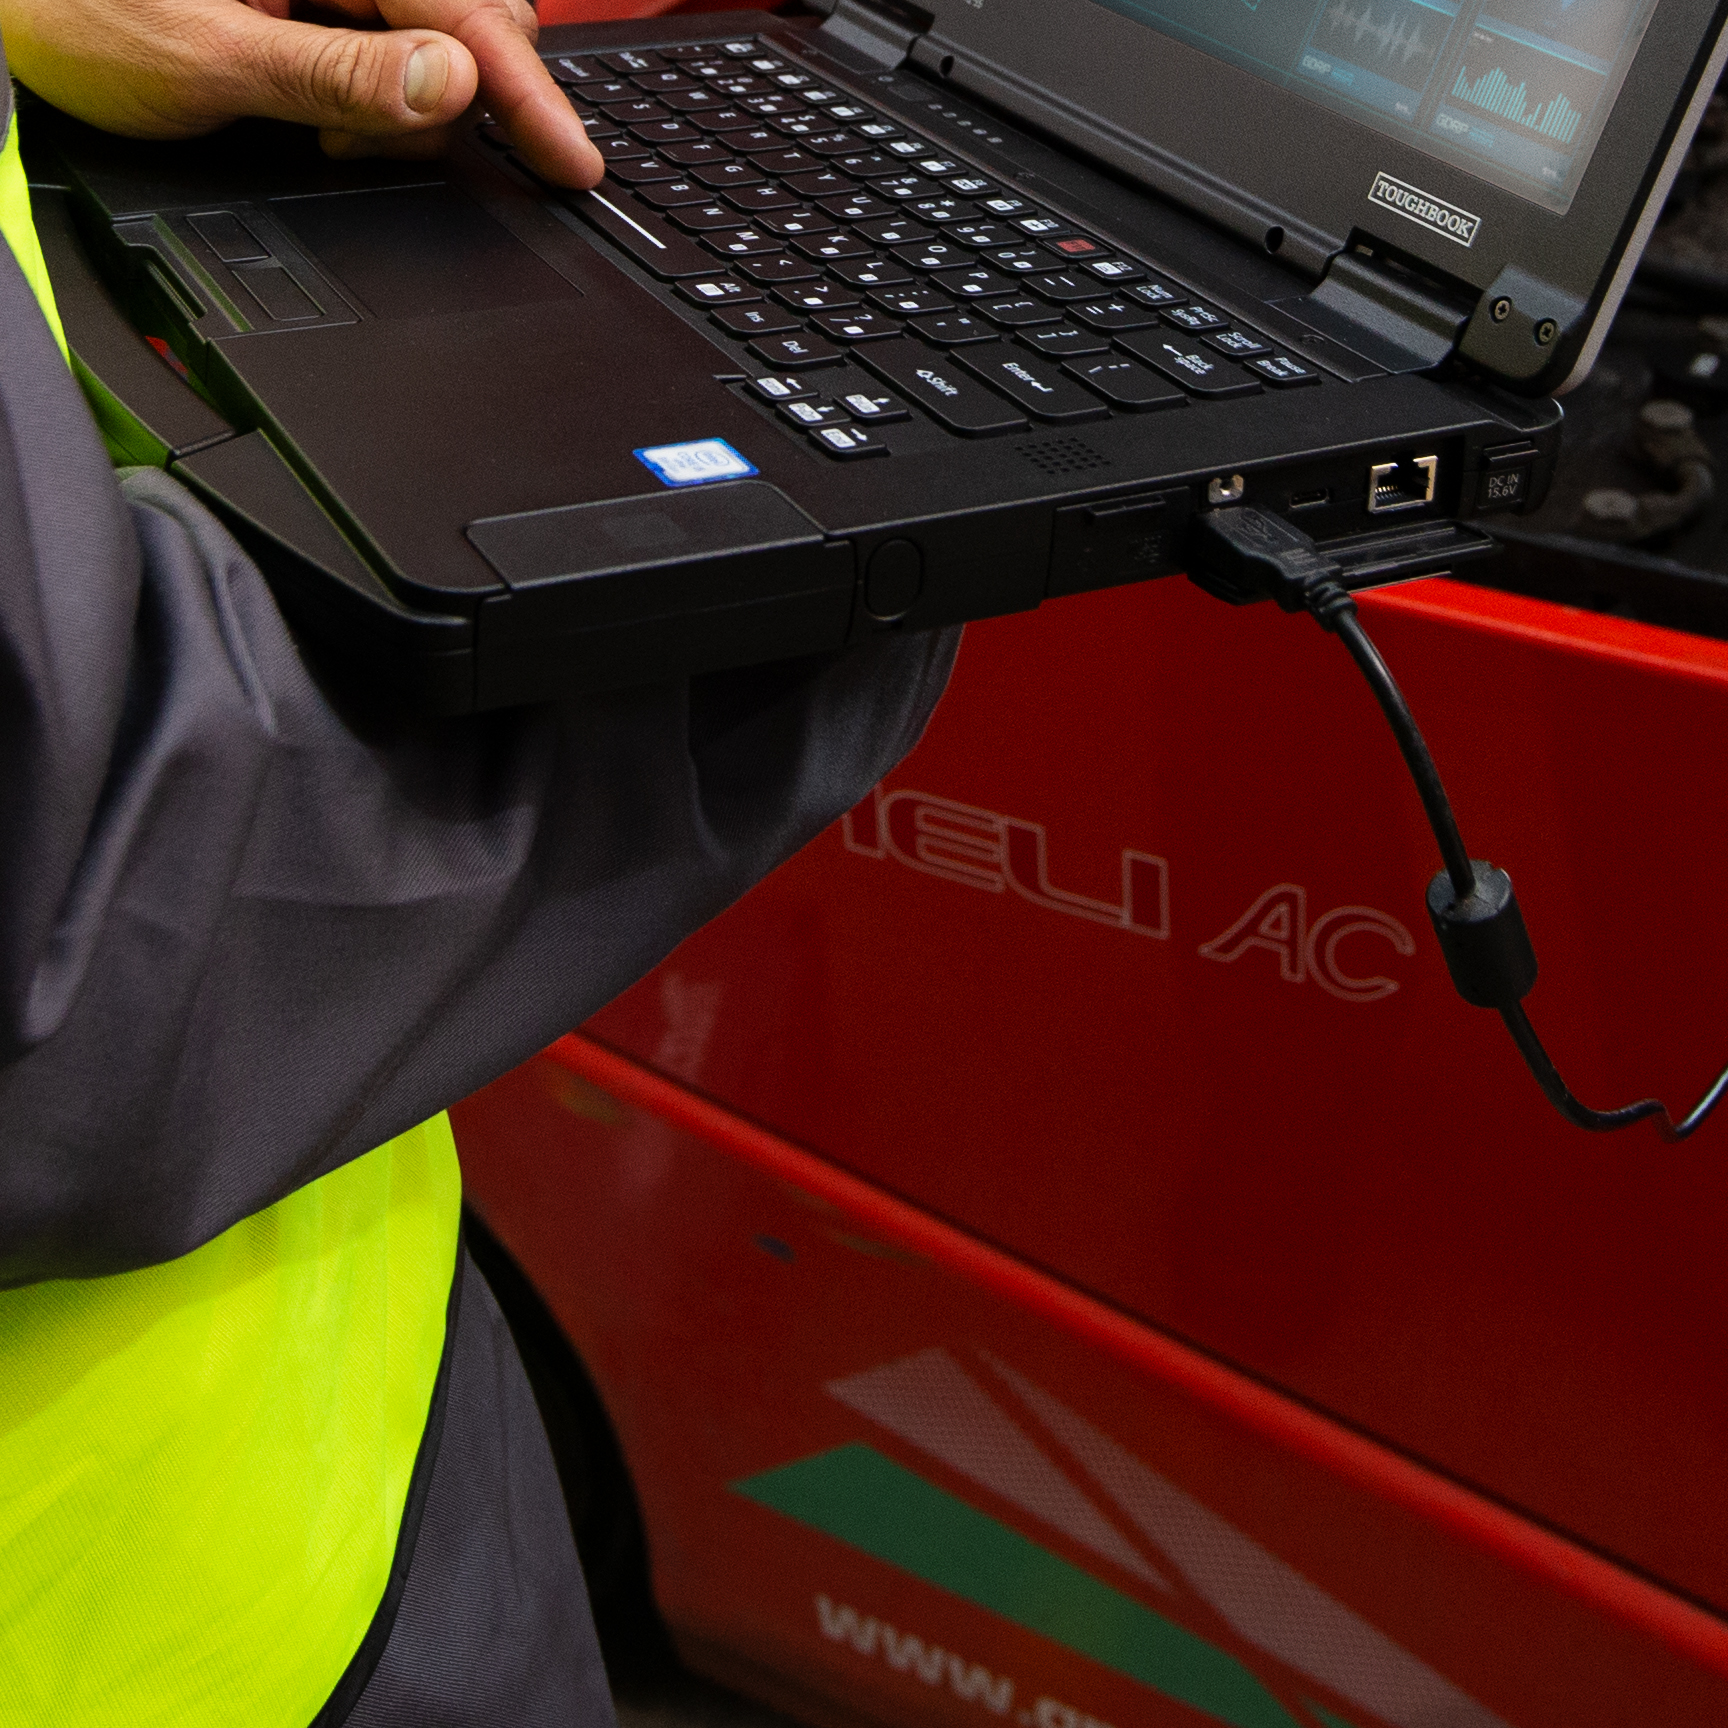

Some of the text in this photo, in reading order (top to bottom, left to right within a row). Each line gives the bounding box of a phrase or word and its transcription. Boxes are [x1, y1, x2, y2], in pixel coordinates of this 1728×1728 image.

[724, 165, 744, 174] G
[670, 184, 690, 192] B
[756, 188, 778, 196] H
[852, 196, 872, 204] U
[702, 207, 724, 216] N
[1375, 179, 1475, 239] TOUGHBOOK
[736, 230, 760, 241] M
[827, 234, 849, 244] K
[968, 272, 989, 280] P
[782, 340, 810, 354] Del
[929, 374, 960, 398] Shift
[1488, 473, 1520, 488] DC IN
[1488, 484, 1518, 499] 15.6V
[1197, 881, 1418, 1003] AC
